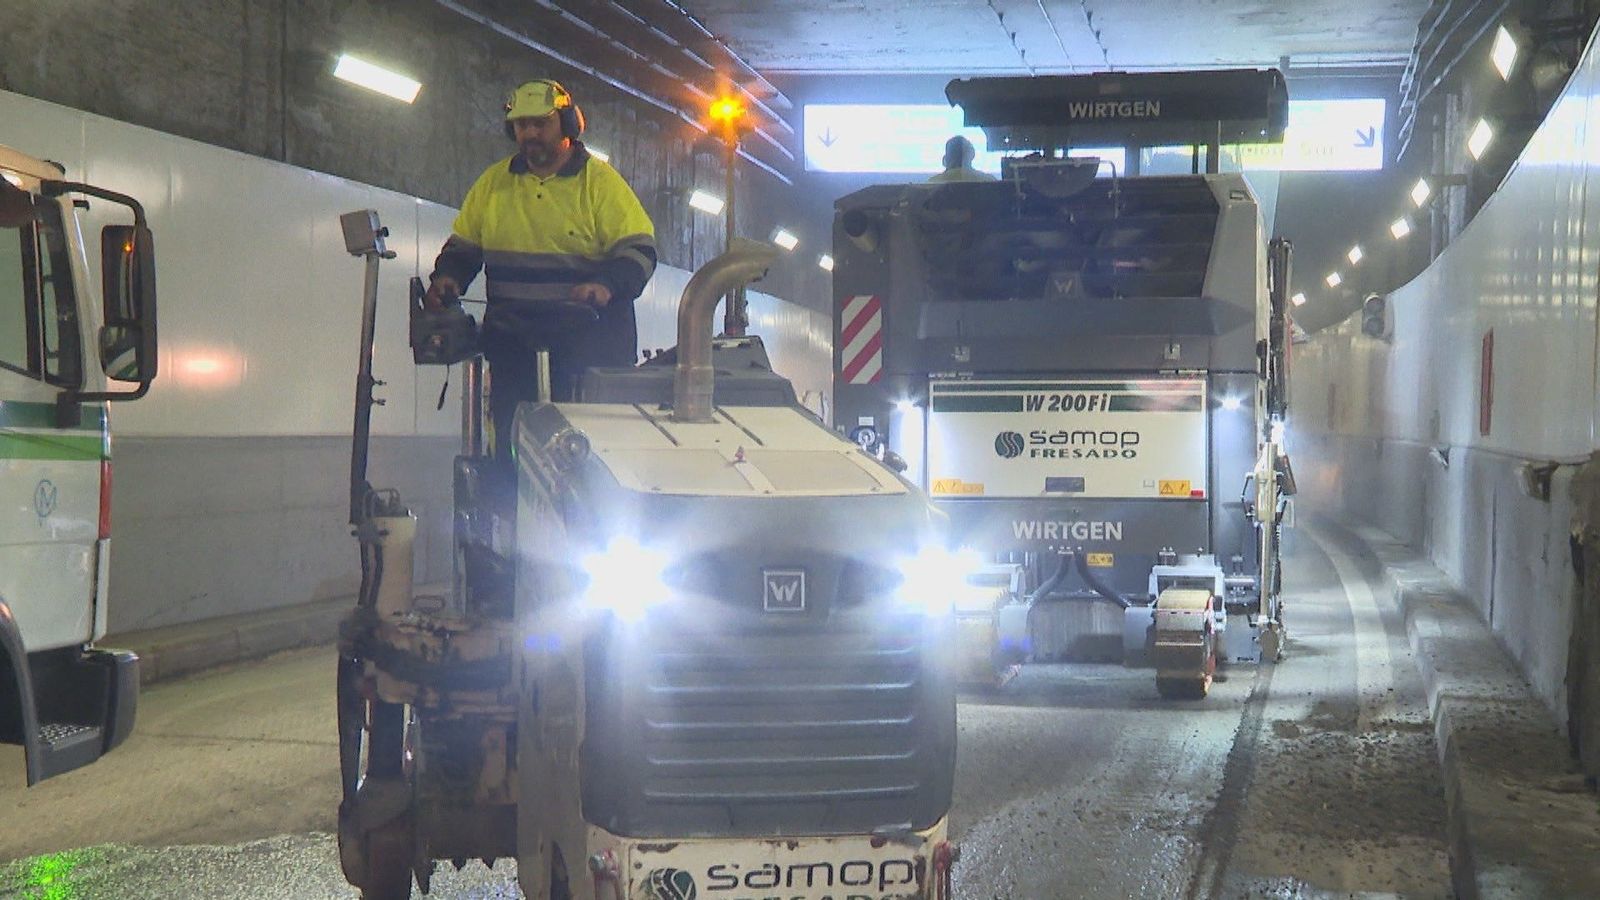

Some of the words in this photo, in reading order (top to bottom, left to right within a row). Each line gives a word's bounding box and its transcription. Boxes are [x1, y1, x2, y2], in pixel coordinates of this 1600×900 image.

[1068, 100, 1161, 118] WIRTGEN
[1026, 395, 1045, 412] W
[1029, 431, 1140, 448] samop
[1030, 448, 1137, 459] FRESADO
[1012, 520, 1123, 541] WIRTGEN
[769, 580, 798, 602] W
[707, 860, 914, 892] samop
